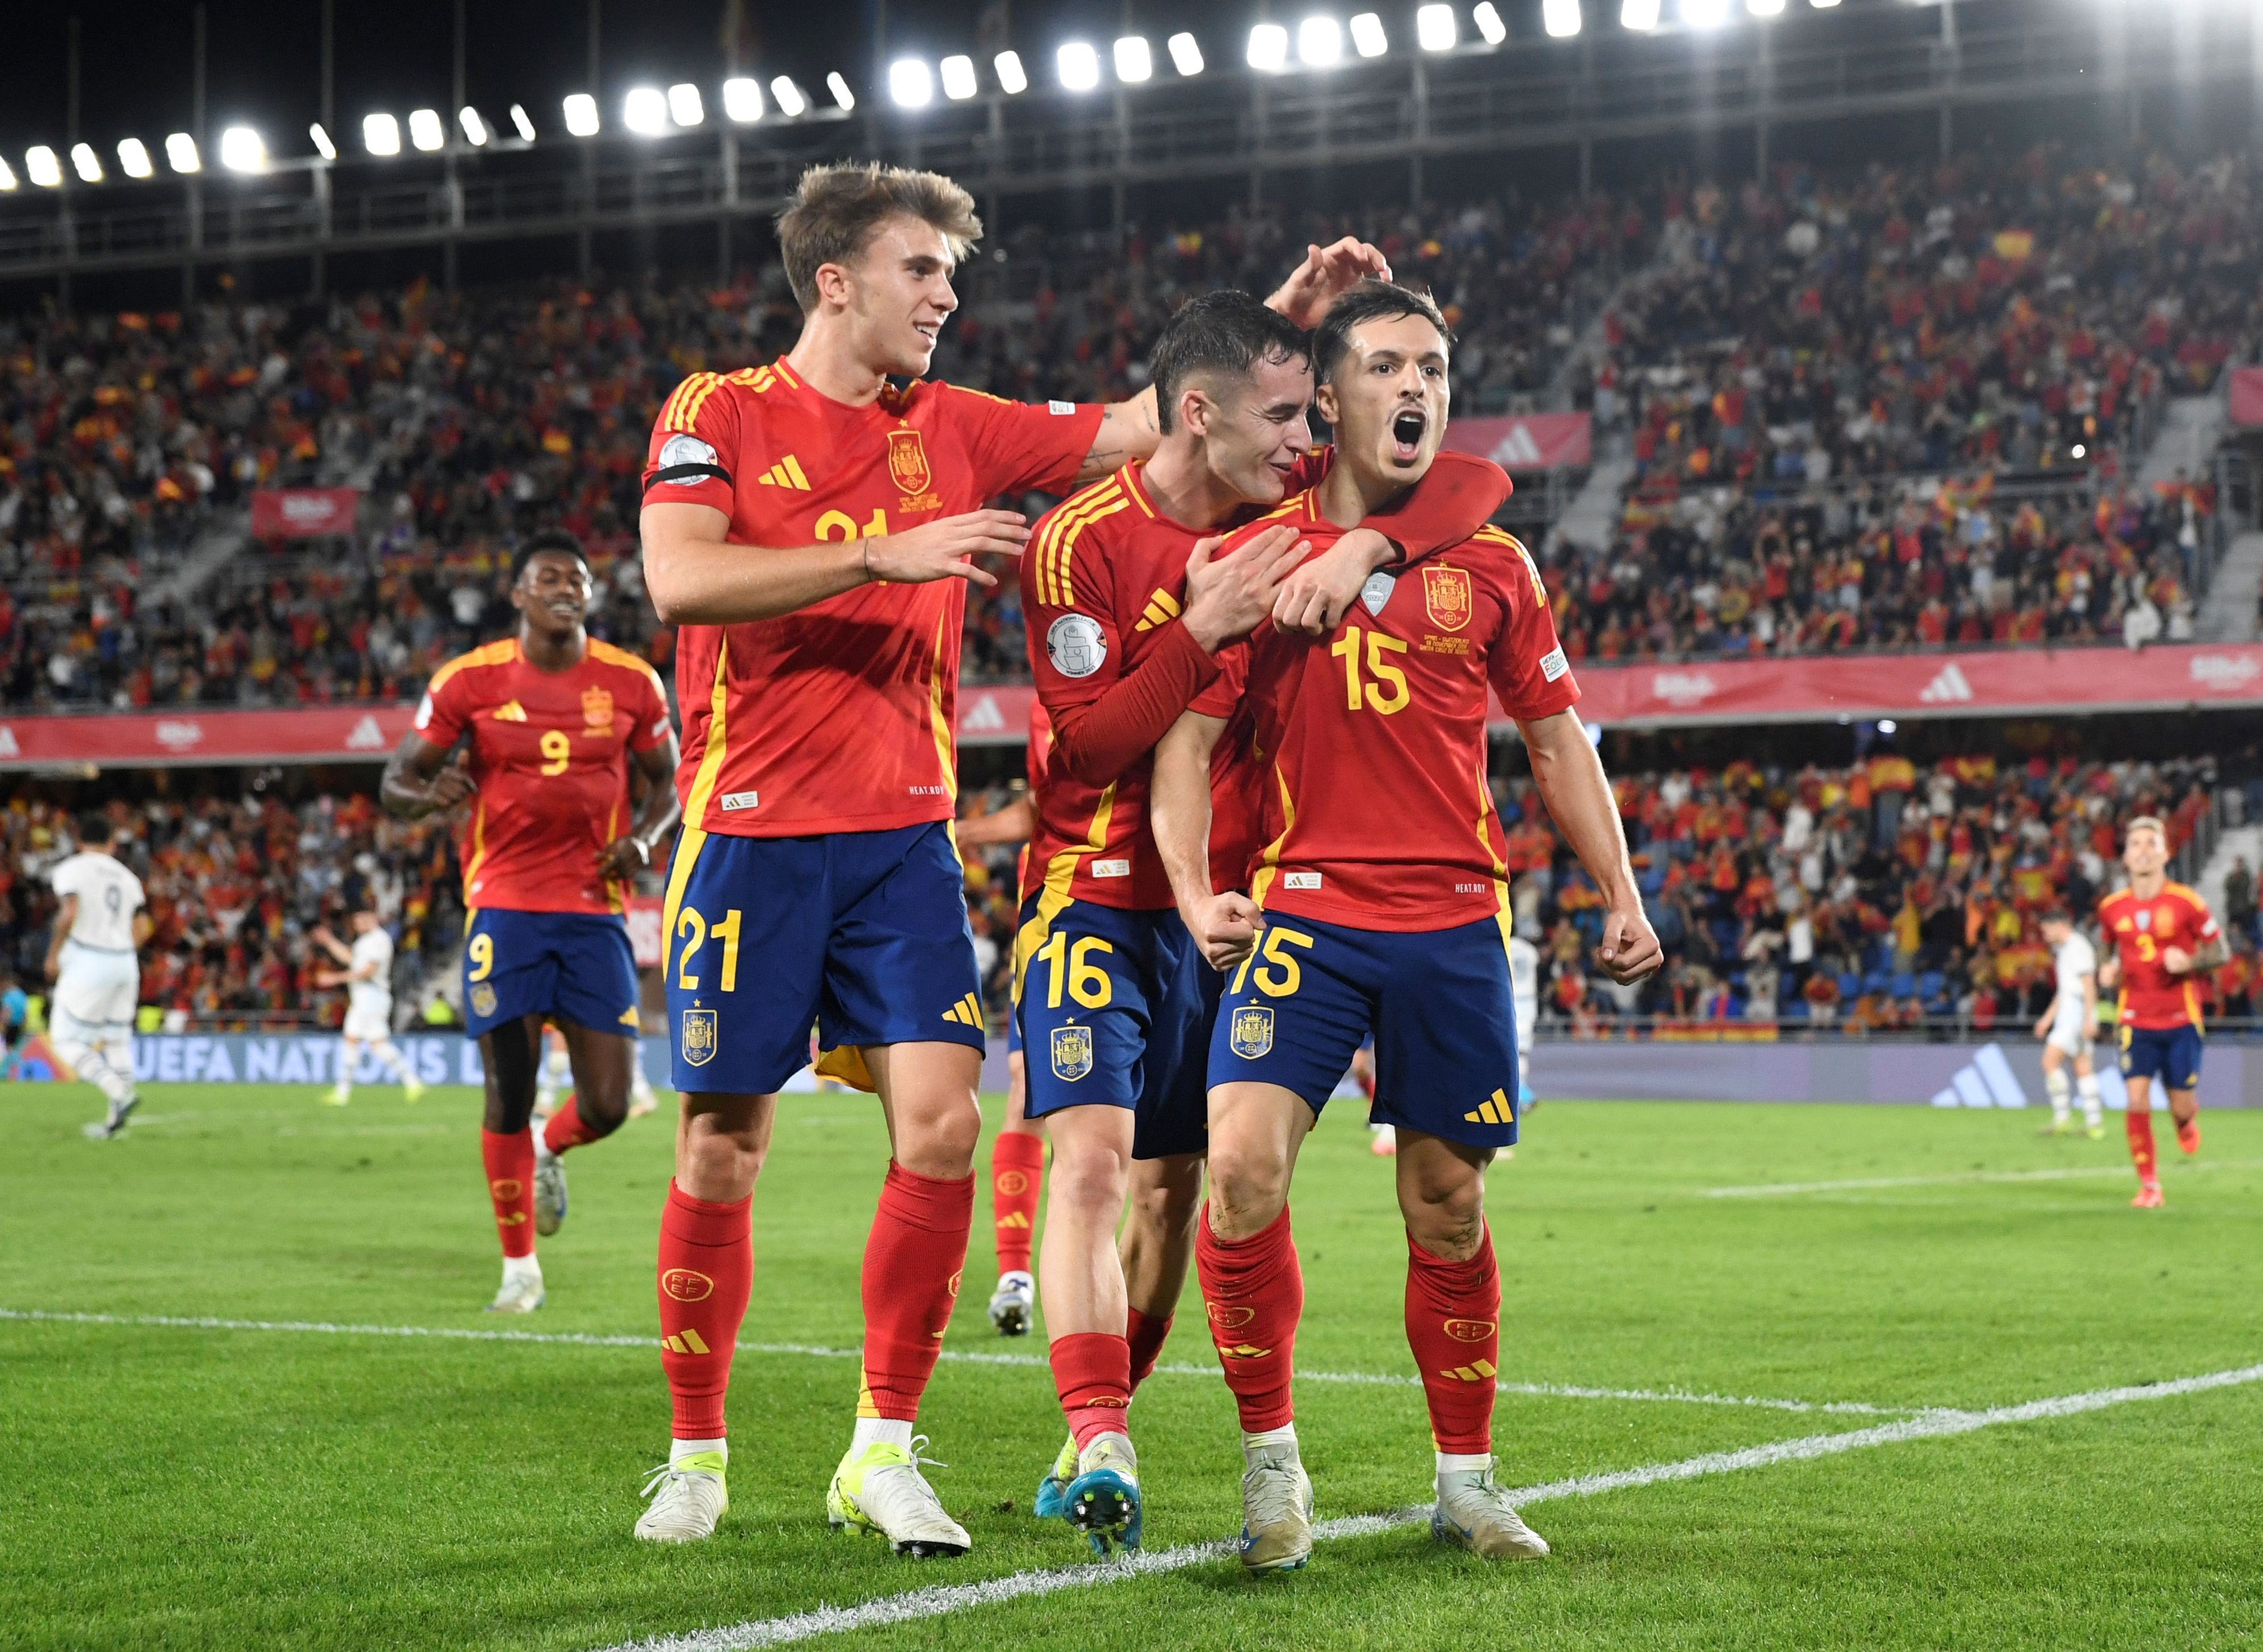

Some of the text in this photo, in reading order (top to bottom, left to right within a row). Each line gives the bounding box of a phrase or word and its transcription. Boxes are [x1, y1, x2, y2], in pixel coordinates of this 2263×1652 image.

[1332, 627, 1410, 715] 15
[540, 729, 570, 777] 9
[468, 932, 494, 982] 9
[678, 907, 742, 992] 21
[1037, 931, 1113, 1009] 16
[2136, 933, 2157, 962] 3
[131, 1036, 235, 1082] UEFA
